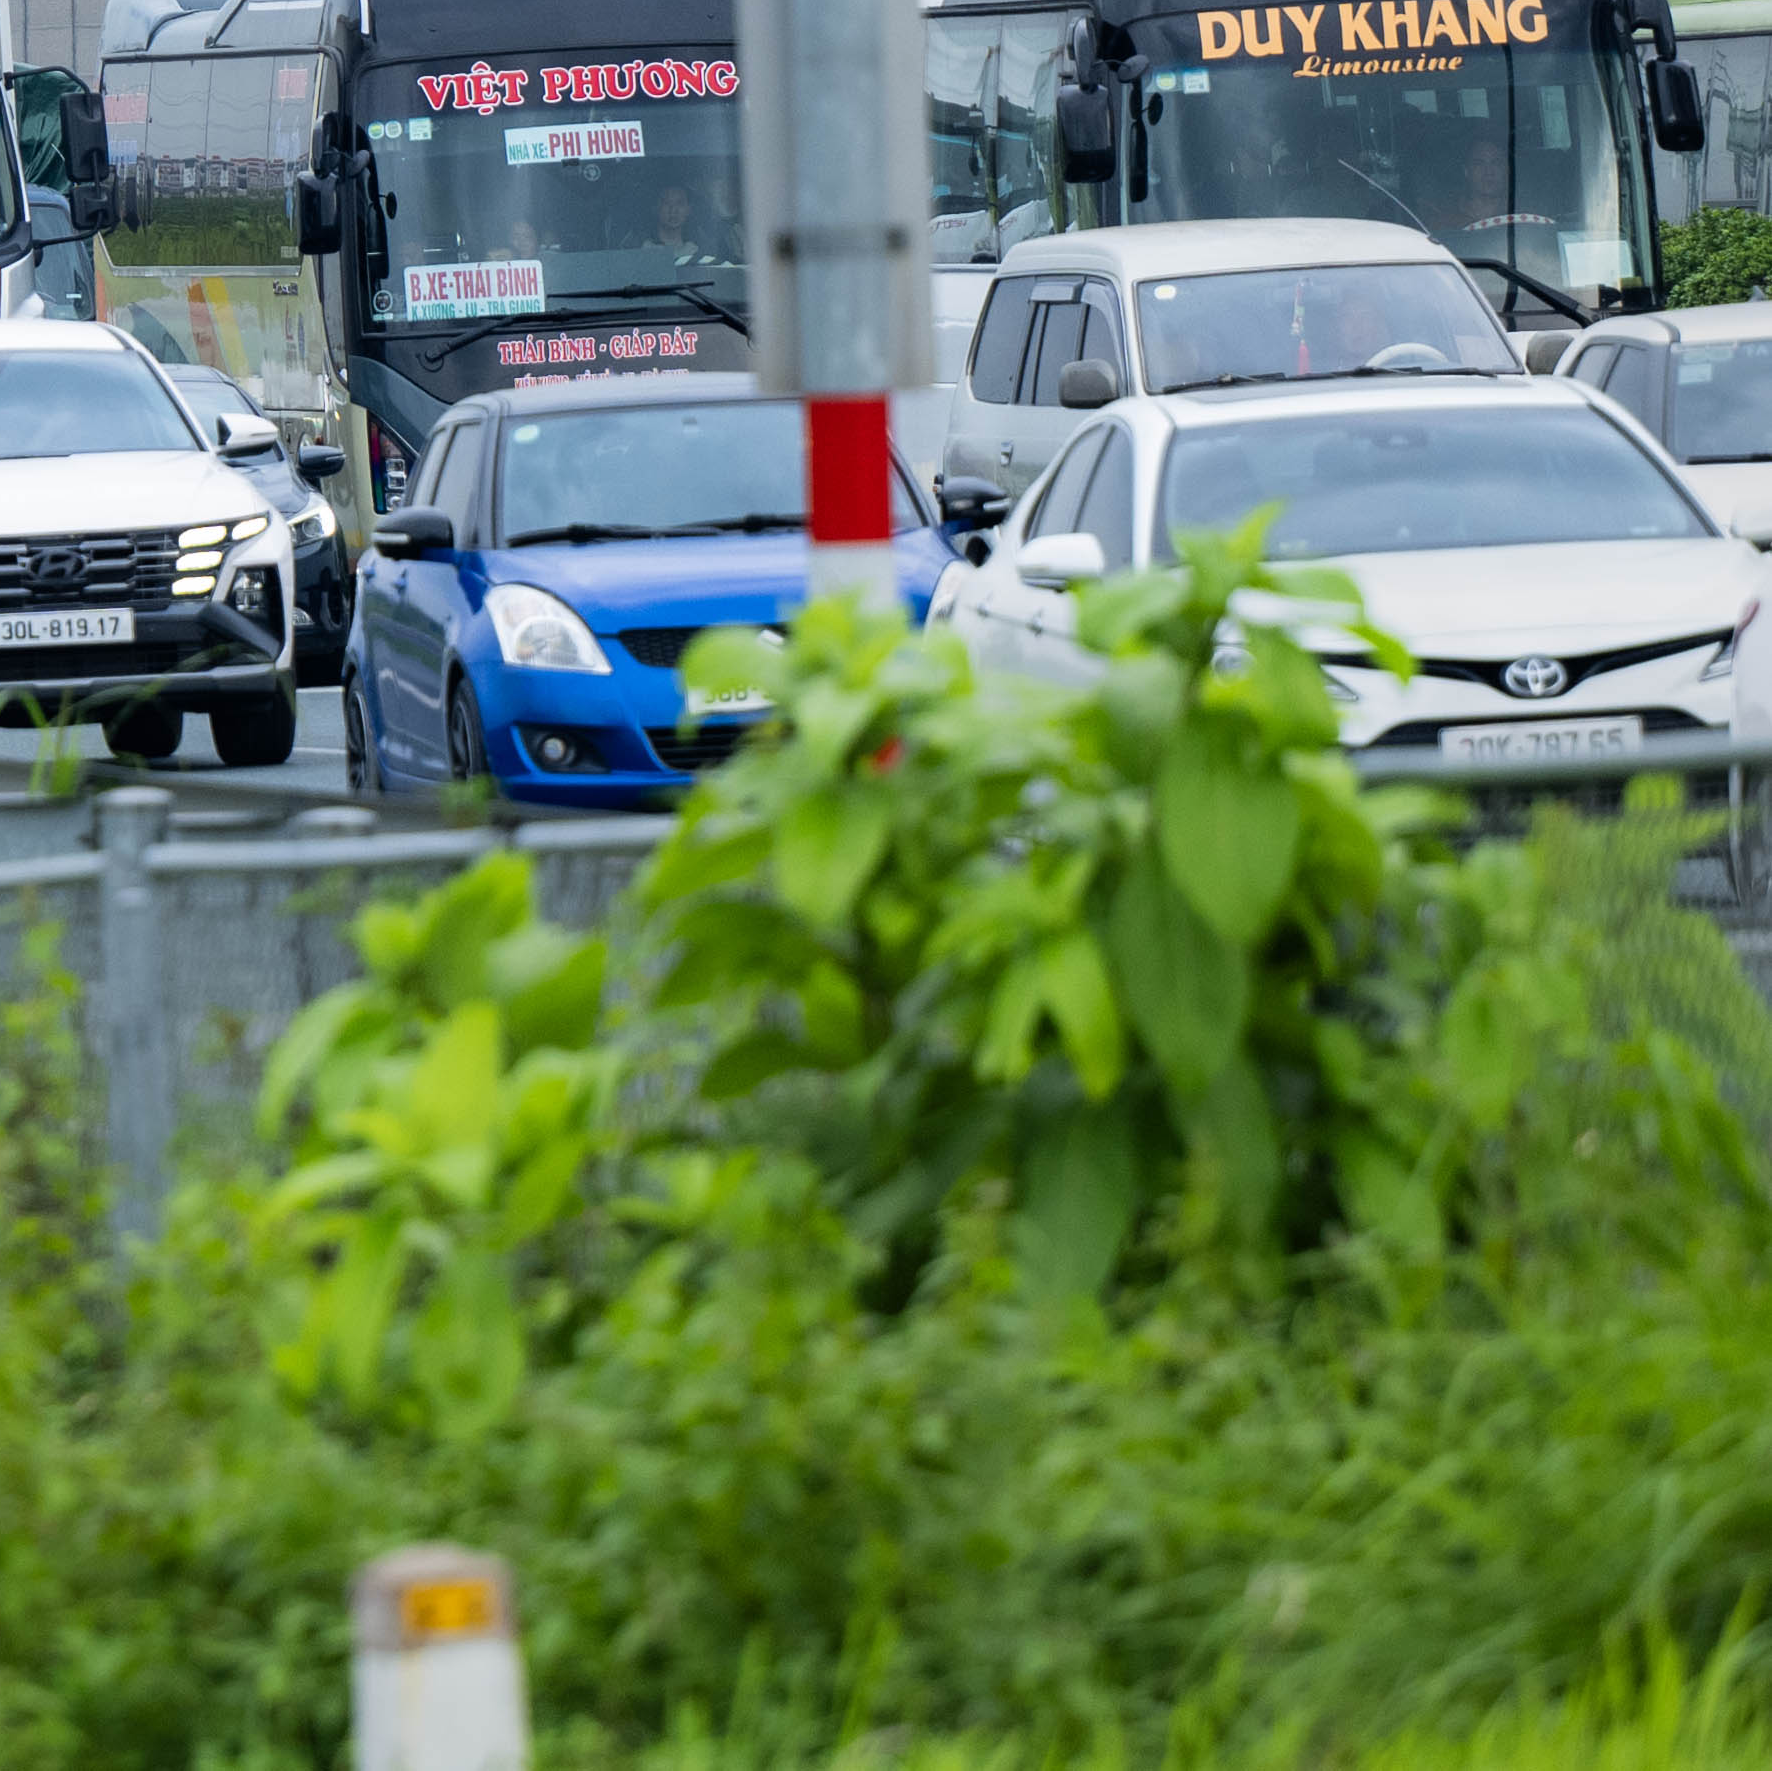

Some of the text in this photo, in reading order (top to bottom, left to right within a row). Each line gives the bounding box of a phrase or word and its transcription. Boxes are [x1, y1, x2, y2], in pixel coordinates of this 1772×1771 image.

[1197, 3, 1326, 61] DUY
[1292, 51, 1465, 79] Limousine
[417, 58, 740, 116] VIỆT PHƯƠNG
[508, 142, 530, 162] NHÀ
[548, 131, 582, 158] PHI
[587, 124, 642, 156] HÙNG
[496, 261, 539, 297] BÌNH
[498, 325, 698, 365] THÁI BÌNH GIÁP BÁT
[1, 616, 120, 641] 30L-819.17
